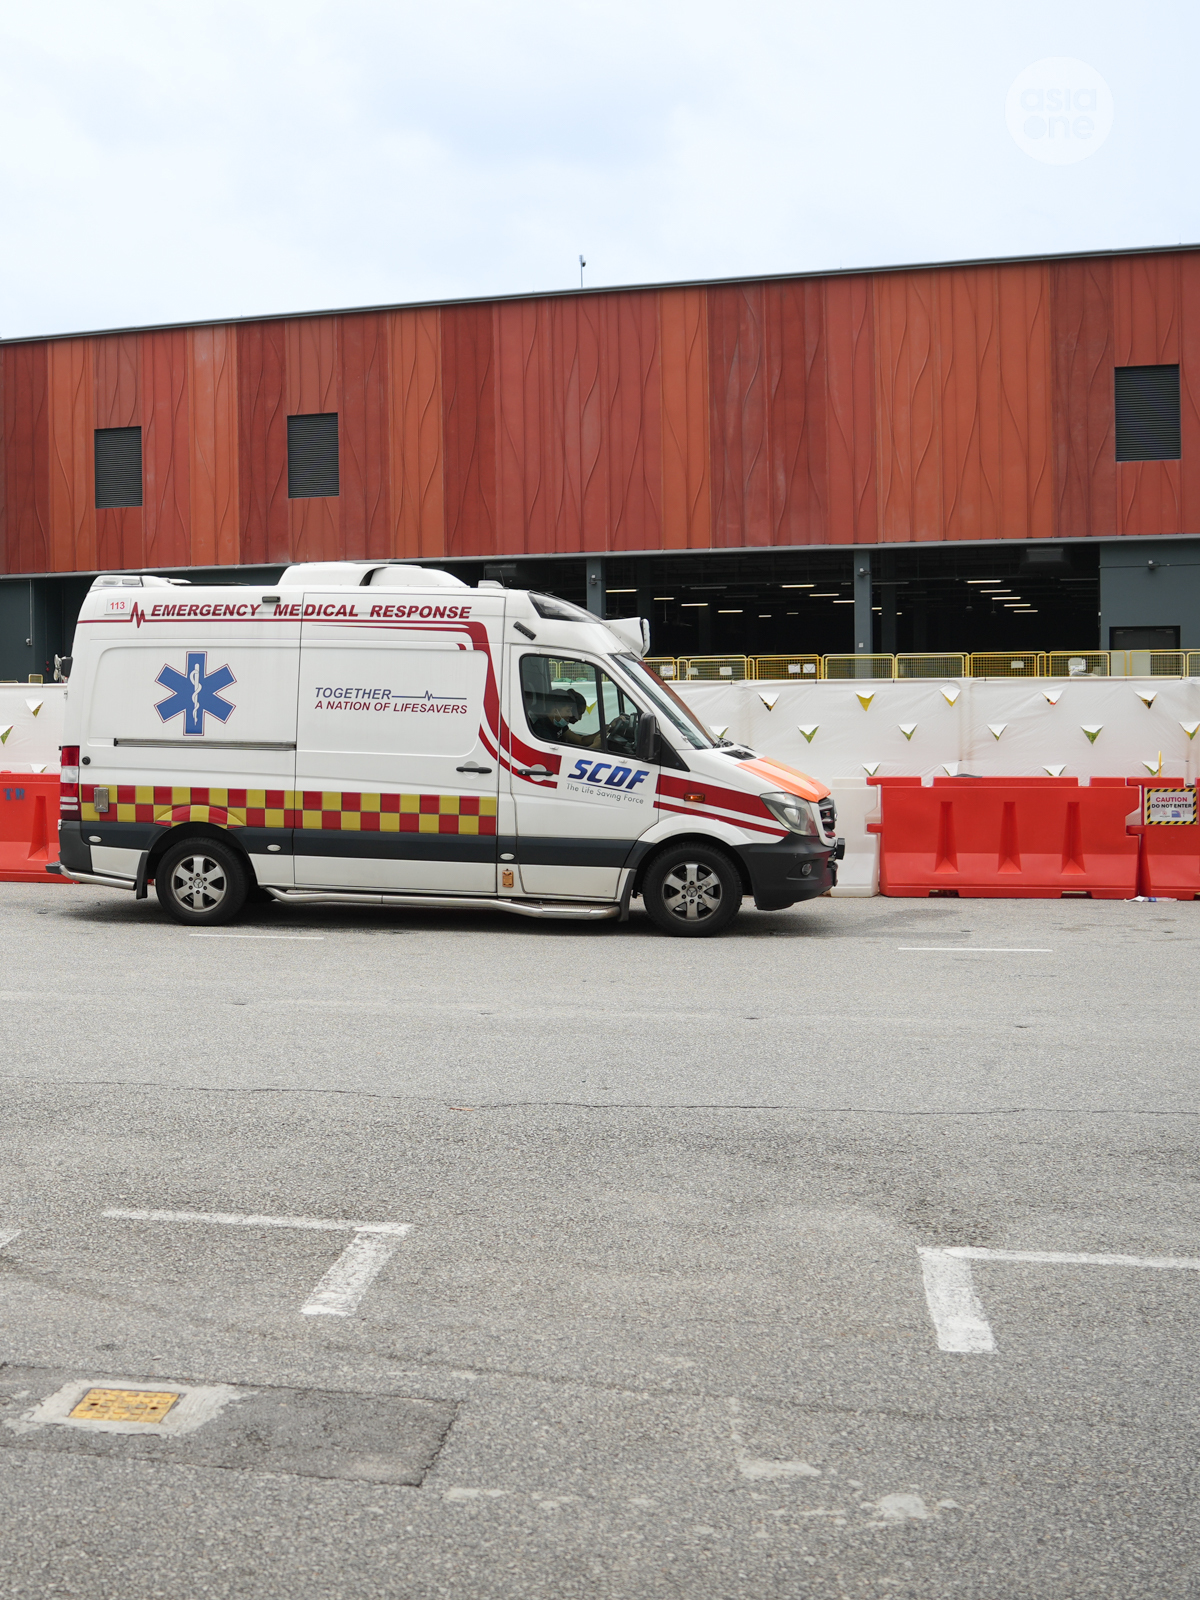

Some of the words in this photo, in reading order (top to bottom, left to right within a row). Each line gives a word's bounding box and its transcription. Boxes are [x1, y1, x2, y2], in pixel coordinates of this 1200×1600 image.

[109, 601, 126, 610] 113
[151, 604, 262, 617] EMERGENCY
[273, 603, 359, 618] MEDICAL
[369, 605, 472, 619] RESPONSE
[315, 687, 392, 700] TOGETHER
[314, 700, 323, 710] A
[326, 700, 371, 712] NATION
[373, 702, 391, 712] OF
[393, 703, 468, 715] LIFESAVERS
[567, 759, 650, 790] SCDF
[3, 788, 25, 800] TB
[566, 783, 579, 792] The
[581, 786, 594, 795] Life
[596, 789, 621, 802] Saving
[623, 794, 644, 805] Force
